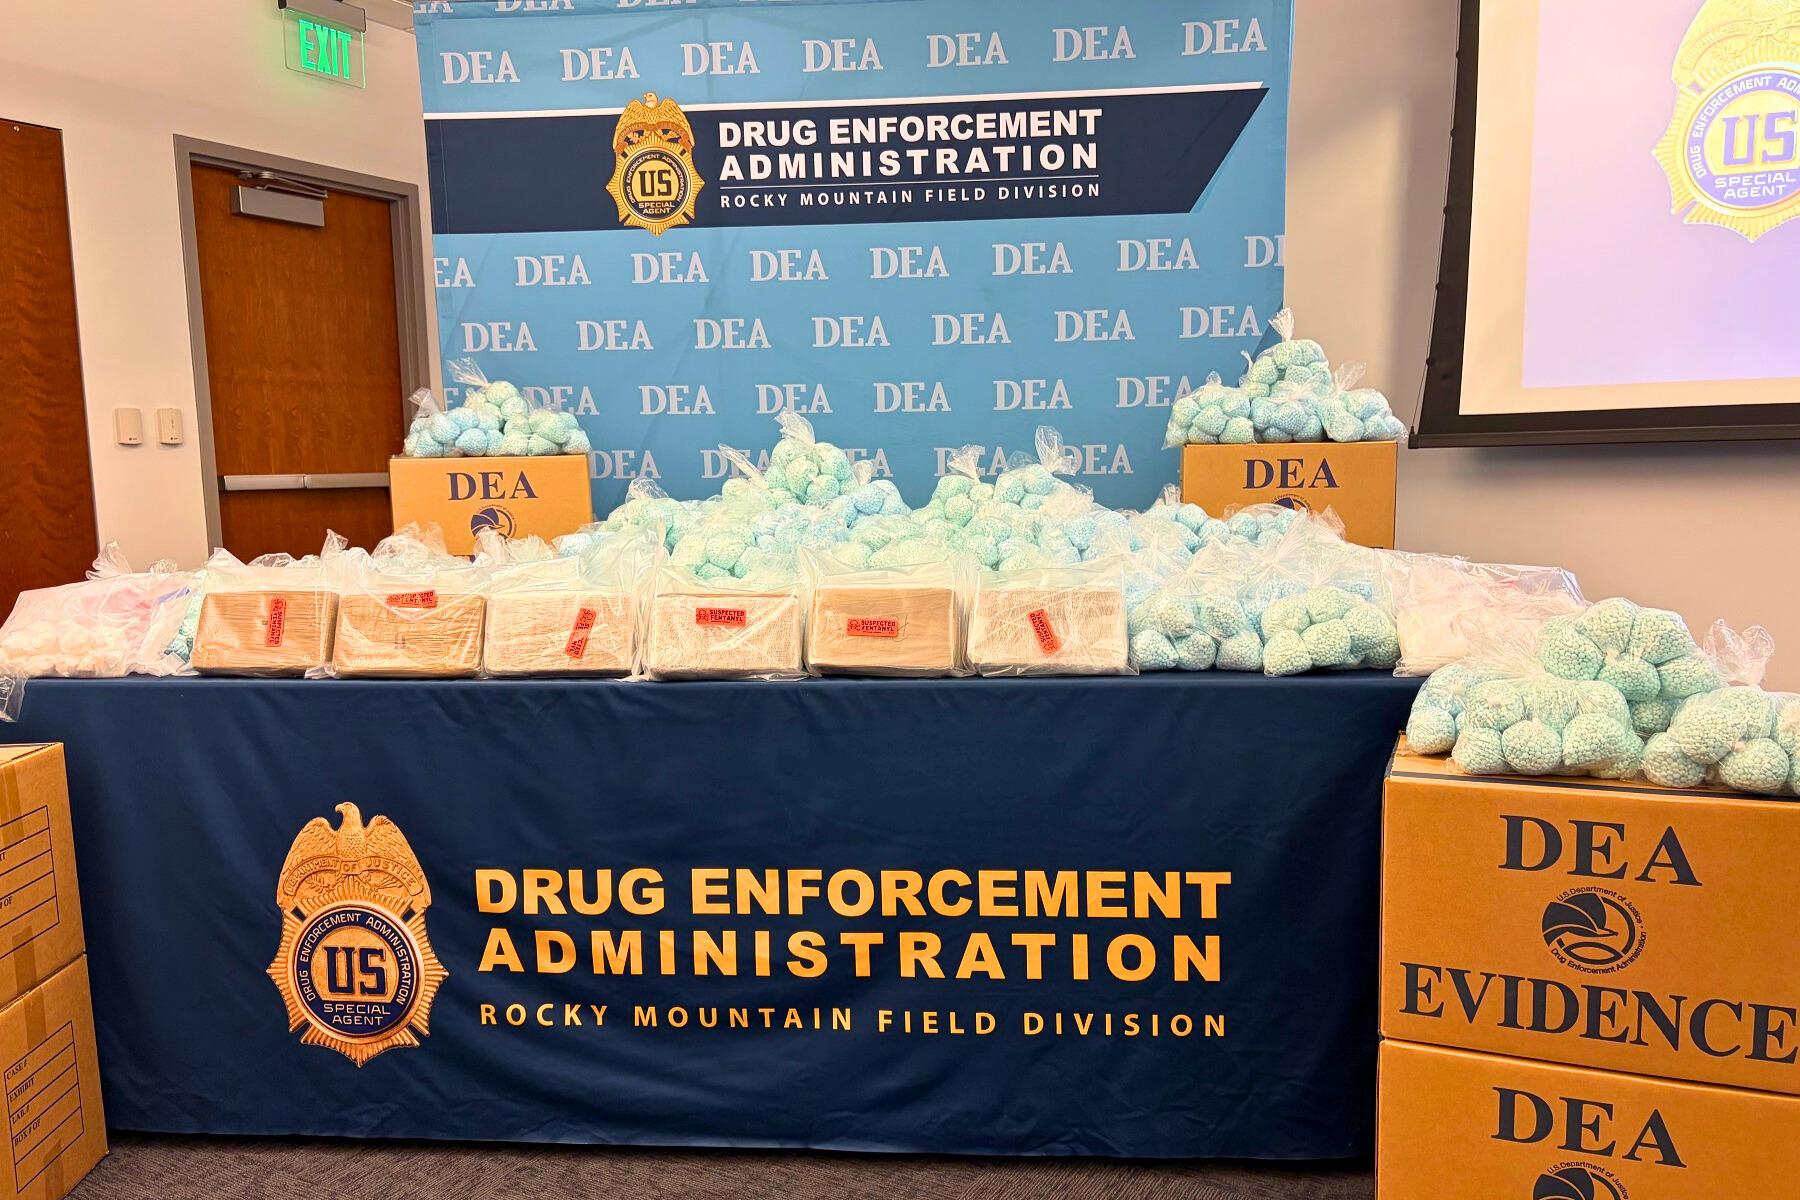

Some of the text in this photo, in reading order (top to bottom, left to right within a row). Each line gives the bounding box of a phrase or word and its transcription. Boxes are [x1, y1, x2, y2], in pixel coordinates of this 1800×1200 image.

[299, 20, 352, 79] EXIT
[926, 32, 1008, 68] DEA
[1053, 25, 1136, 62] DEA
[1182, 18, 1267, 56] DEA
[440, 51, 520, 84] DEA
[560, 47, 640, 81] DEA
[680, 41, 760, 76] DEA
[802, 38, 883, 72] DEA
[1692, 75, 1773, 138] ENFORCEMENT
[719, 119, 817, 148] DRUG
[830, 108, 1102, 146] ENFORCEMENT
[1722, 110, 1797, 166] US
[719, 142, 1097, 181] ADMINISTRATION
[1690, 145, 1707, 179] DRUG
[638, 169, 672, 196] US
[721, 183, 1100, 208] ROCKY MOUNTAIN FIELD DIVISION
[1715, 172, 1796, 189] SPECIAL
[1724, 184, 1787, 200] AGENT
[638, 201, 675, 209] SPECIAL
[514, 254, 591, 286] DEA
[631, 251, 709, 285] DEA
[749, 248, 828, 282] DEA
[870, 245, 949, 279] DEA
[992, 241, 1073, 276] DEA
[1117, 237, 1199, 272] DEA
[461, 321, 537, 353] DEA
[576, 319, 654, 351] DEA
[693, 317, 771, 350] DEA
[812, 314, 891, 348] DEA
[932, 312, 1011, 346] DEA
[1054, 309, 1135, 343] DEA
[1179, 305, 1262, 339] DEA
[639, 384, 716, 415] DEA
[756, 383, 832, 414] DEA
[873, 381, 951, 413] DEA
[993, 378, 1073, 411] DEA
[590, 449, 661, 479] DEA
[1242, 457, 1340, 489] DEA
[447, 470, 539, 501] DEA
[709, 609, 745, 617] SUSPECTED
[1498, 814, 1703, 887] DEA
[343, 863, 357, 872] OF
[366, 857, 416, 887] JUSTICE
[475, 868, 1232, 919] DRUG ENFORCEMENT
[1624, 901, 1643, 924] Justice
[300, 913, 412, 1006] DRUG ENFORCEMENT ADMINISTRATION
[478, 927, 1221, 982] ADMINISTRATION
[1551, 931, 1647, 975] Drug Enforcement Administration
[323, 946, 386, 995] US
[323, 1003, 391, 1015] SPECIAL
[332, 1015, 383, 1026] AGENT
[480, 1003, 1225, 1037] ROCKY MOUNTAIN FIELD DIVISION
[1398, 962, 1800, 1064] EVIDENCE
[6, 1063, 24, 1080] CASE
[9, 1077, 35, 1102] EXHIBIT
[14, 1130, 28, 1147] BOX
[1491, 1086, 1688, 1168] DEA
